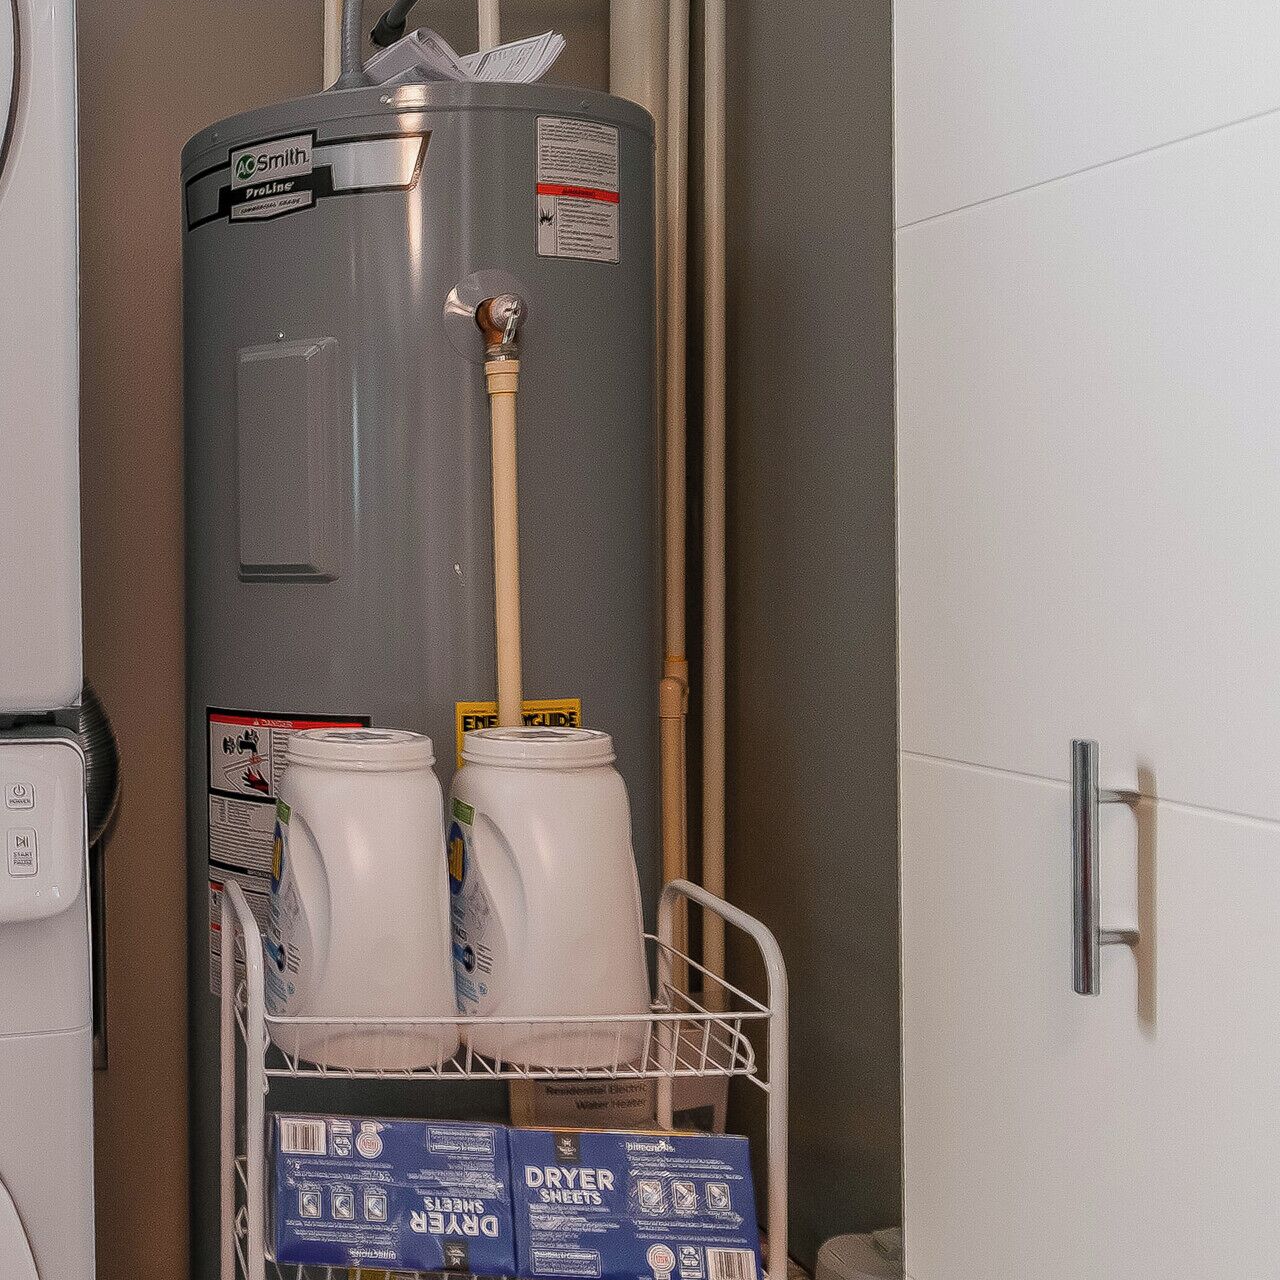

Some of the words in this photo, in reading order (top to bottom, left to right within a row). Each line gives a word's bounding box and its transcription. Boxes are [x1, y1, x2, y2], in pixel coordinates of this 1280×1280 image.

[246, 181, 293, 199] ProLine
[463, 712, 578, 732] ENEYGUIDE
[545, 1086, 607, 1096] Residential
[609, 1084, 648, 1094] Electric
[575, 1099, 609, 1110] Water
[612, 1098, 647, 1108] Heater
[524, 1165, 615, 1191] DRYER
[539, 1188, 603, 1205] SHEETS
[424, 1197, 485, 1214] SHEETS
[410, 1210, 499, 1238] DRYER
